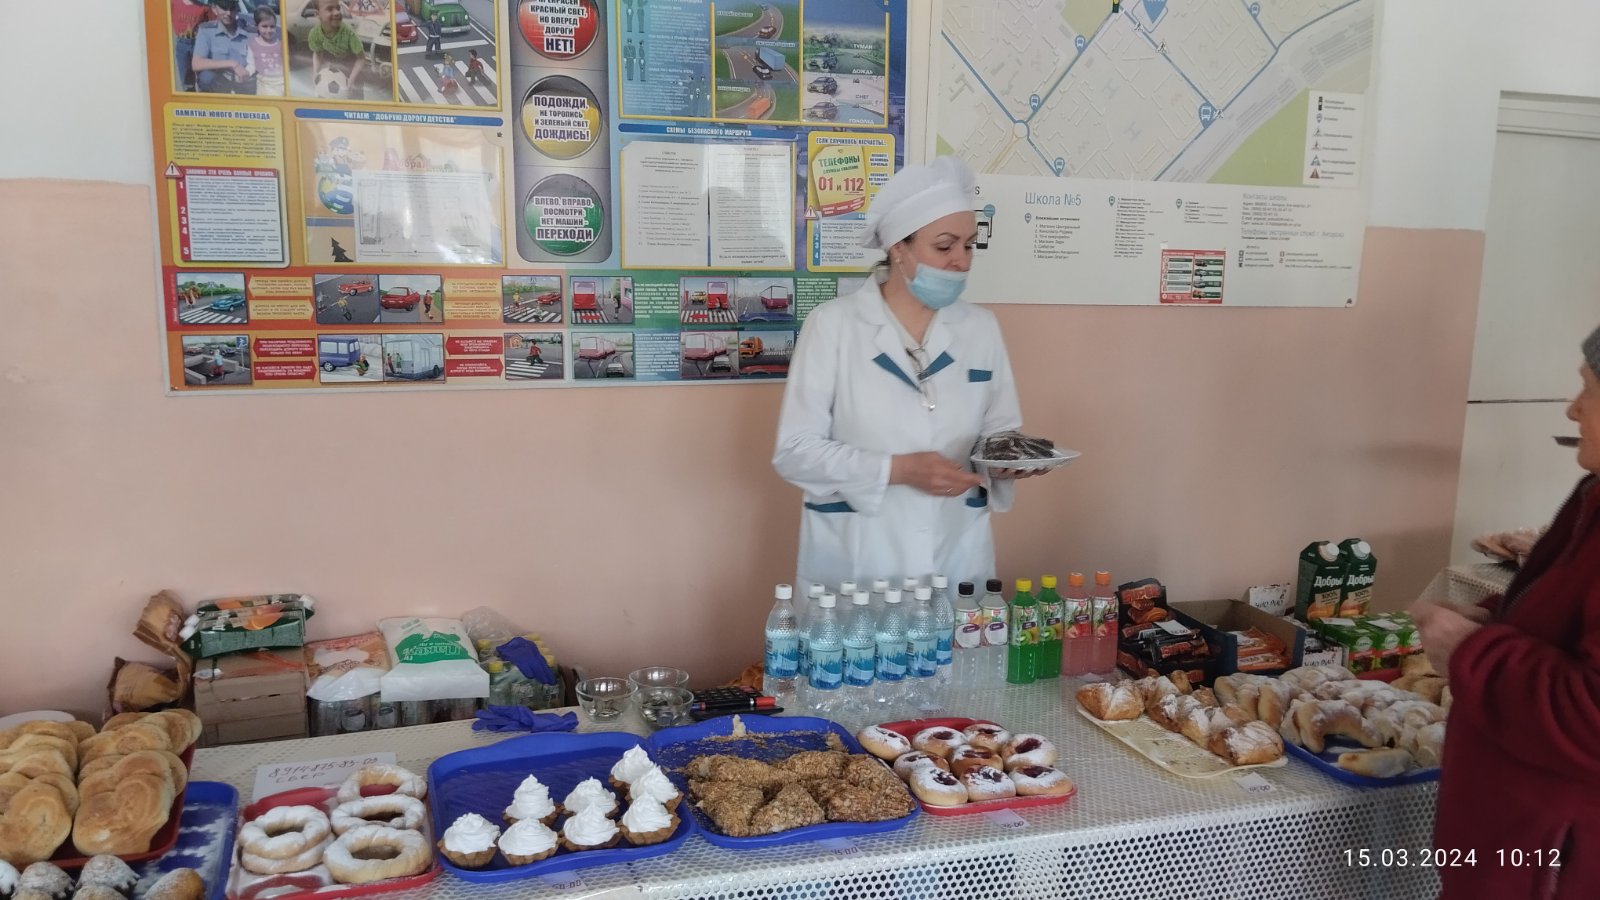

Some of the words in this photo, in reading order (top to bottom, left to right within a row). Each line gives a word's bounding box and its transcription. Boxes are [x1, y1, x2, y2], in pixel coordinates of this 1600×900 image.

[530, 5, 566, 14] КРАСНЫЙ
[567, 8, 587, 17] СВЕТ,
[551, 17, 578, 26] ВПЕРЕД
[545, 26, 573, 35] ДОРОГИ
[545, 37, 574, 52] НЕТ!
[534, 96, 588, 109] ПОДОЖДИ,
[175, 109, 207, 117] ПАМЯТКА
[234, 112, 270, 120] ПЕШЕХОДА
[344, 111, 369, 120] ЧИТАЕМ
[402, 114, 427, 122] ДОРОГУ
[549, 110, 583, 118] ТОРОПИСЬ
[540, 119, 572, 127] ЗЕЛЕНЫЙ
[534, 128, 590, 140] ДОЖДИСЬ!
[687, 127, 723, 136] БЕЗОПАСНОГО
[818, 155, 860, 168] ТЕЛЕФОНЫ
[818, 176, 833, 191] 01
[843, 177, 864, 191] 112
[535, 197, 560, 206] ВЛЕВО,
[562, 198, 593, 207] ВПРАВО,
[1025, 192, 1060, 206] Школа
[1064, 193, 1082, 206] №5
[556, 218, 584, 226] МАШИН
[182, 227, 188, 235] 4
[537, 228, 592, 241] ПЕРЕХОДИ
[1346, 574, 1375, 587] Добры
